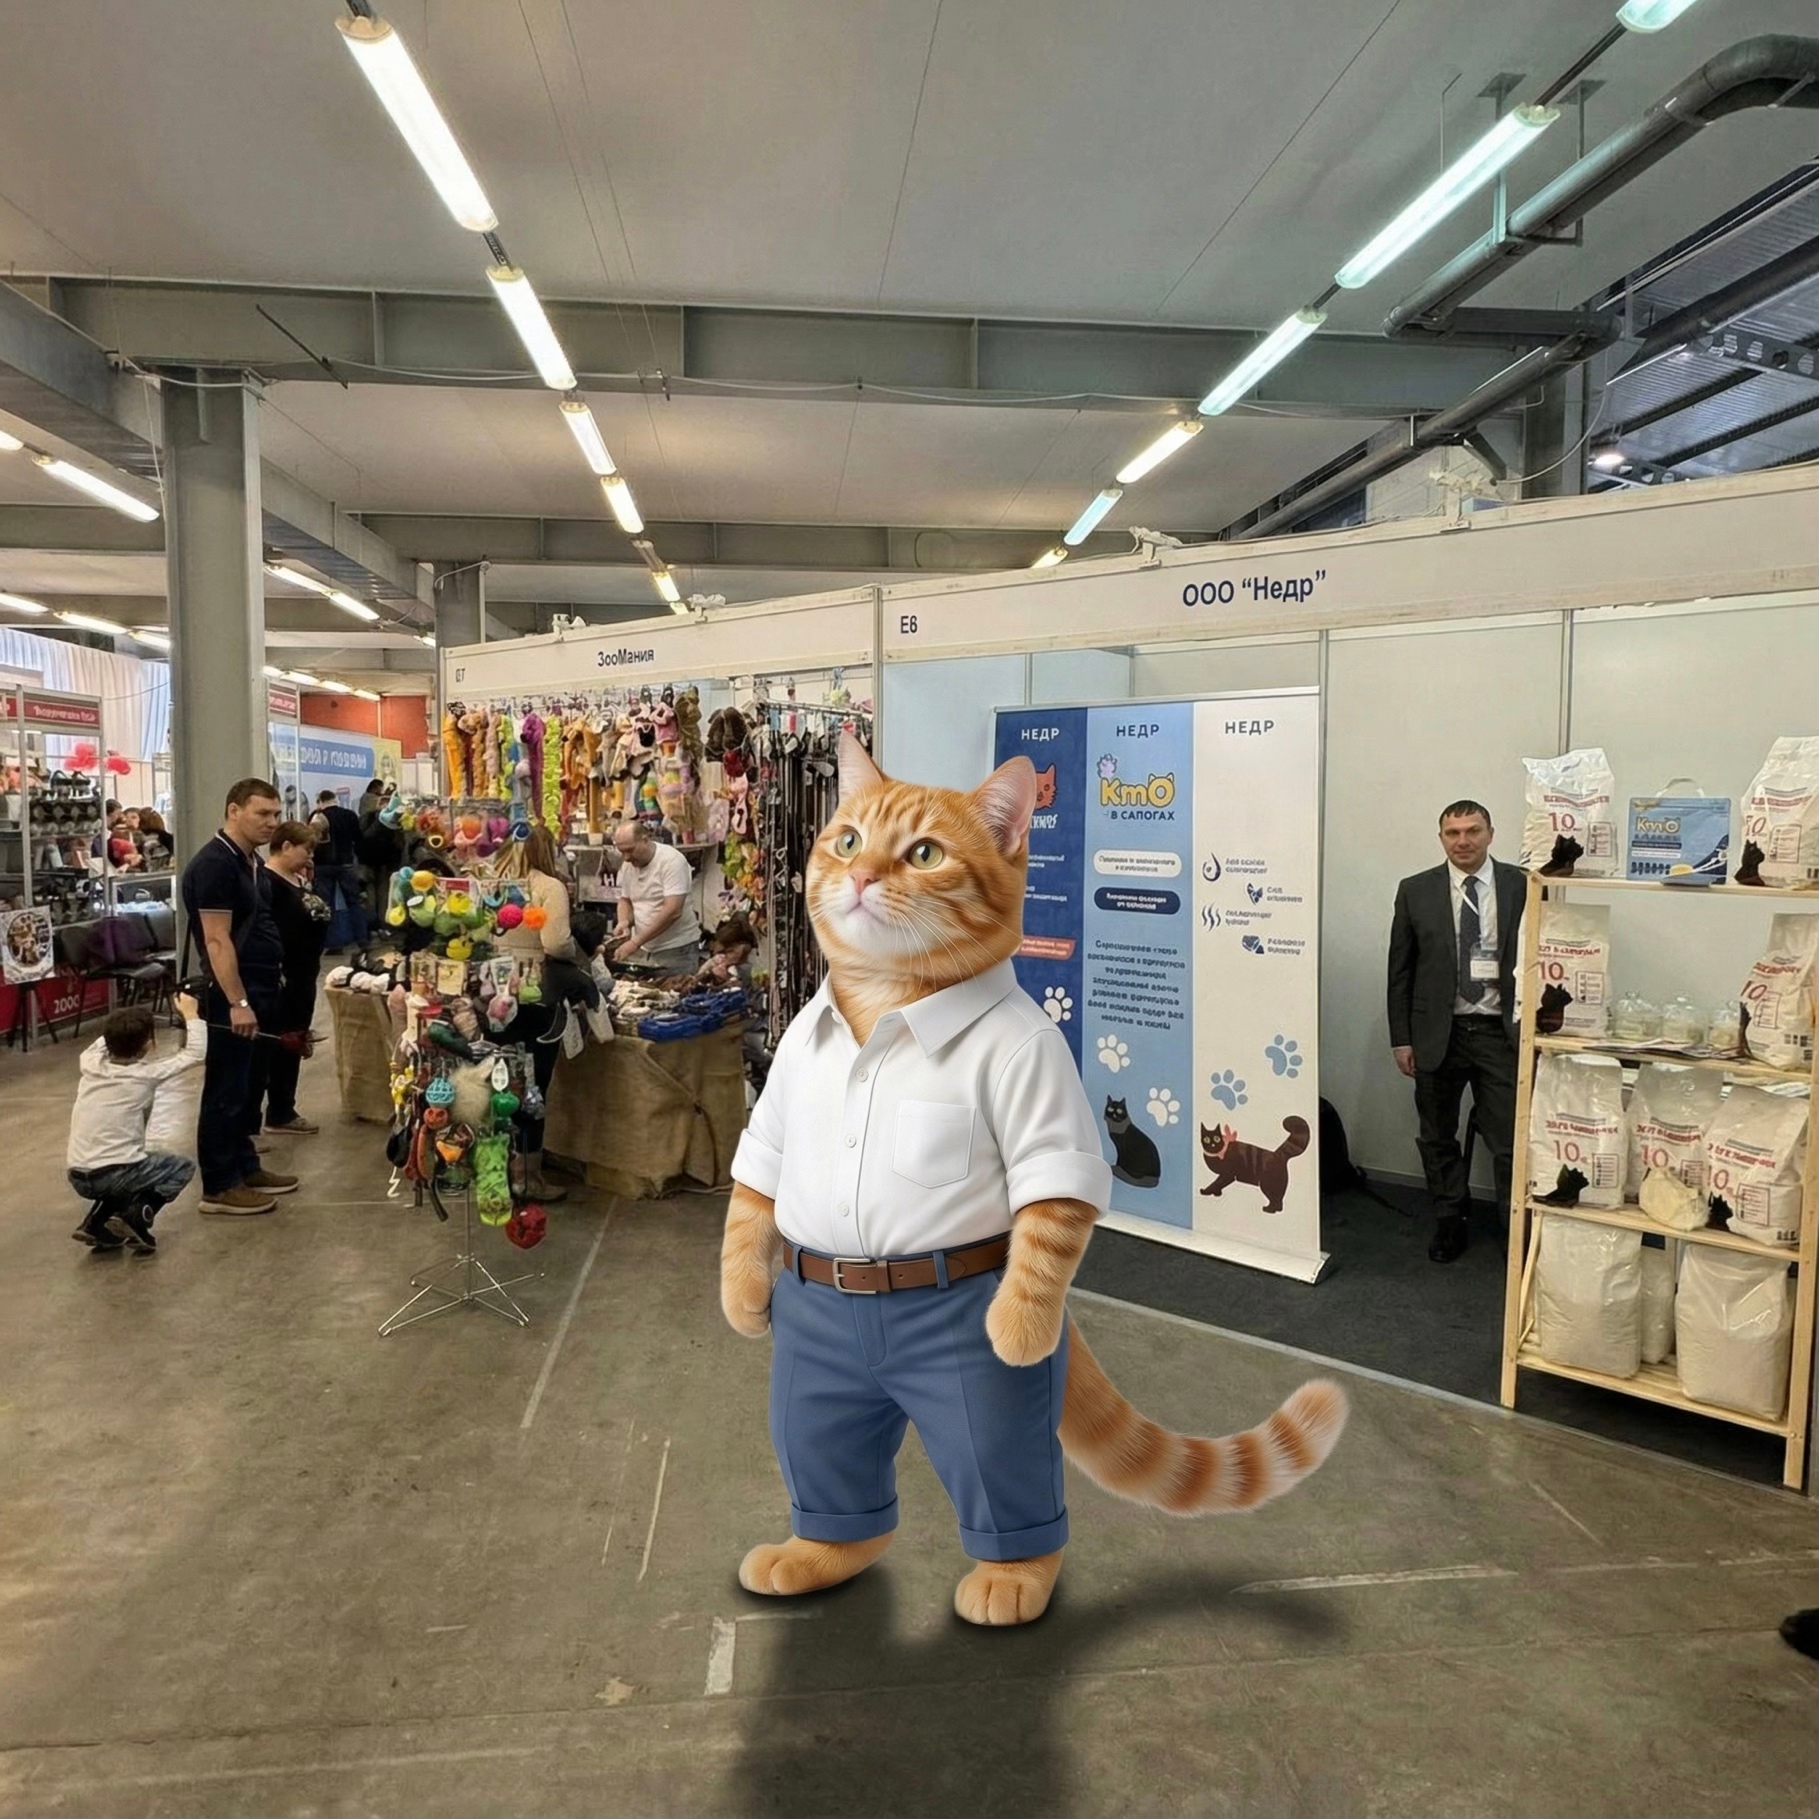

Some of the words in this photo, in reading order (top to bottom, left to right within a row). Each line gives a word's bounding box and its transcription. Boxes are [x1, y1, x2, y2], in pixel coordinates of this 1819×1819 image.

[1181, 582, 1236, 607] ООО
[597, 649, 655, 667] ЗооМания
[1020, 727, 1060, 742] НЕДР
[1116, 723, 1160, 739] НЕДР
[1225, 719, 1274, 736] НЕДР
[1110, 810, 1118, 820] В
[1120, 810, 1175, 821] САПОГАХ
[1548, 812, 1576, 832] 10
[1745, 815, 1767, 836] 10
[1537, 961, 1564, 981] 10
[1740, 980, 1768, 1001] 10
[1553, 1139, 1580, 1163] 10
[1641, 1144, 1669, 1168] 10
